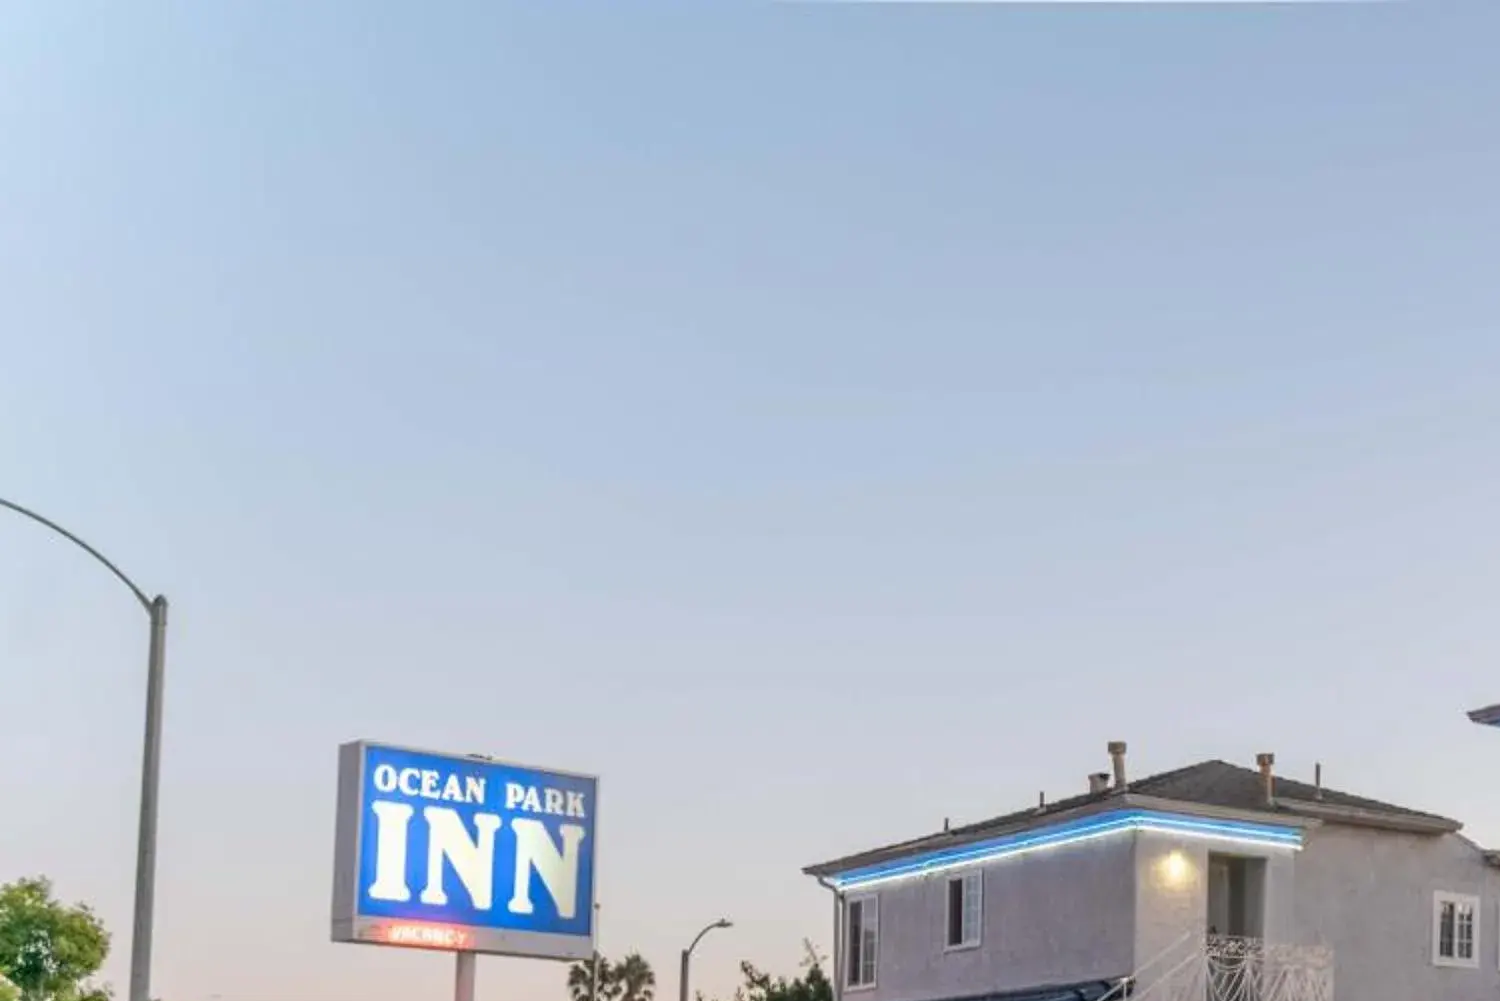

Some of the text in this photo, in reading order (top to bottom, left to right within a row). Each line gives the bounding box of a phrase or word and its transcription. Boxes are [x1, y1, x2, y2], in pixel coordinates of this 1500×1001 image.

[374, 764, 586, 818] OCEAN PARK
[368, 799, 586, 920] INN
